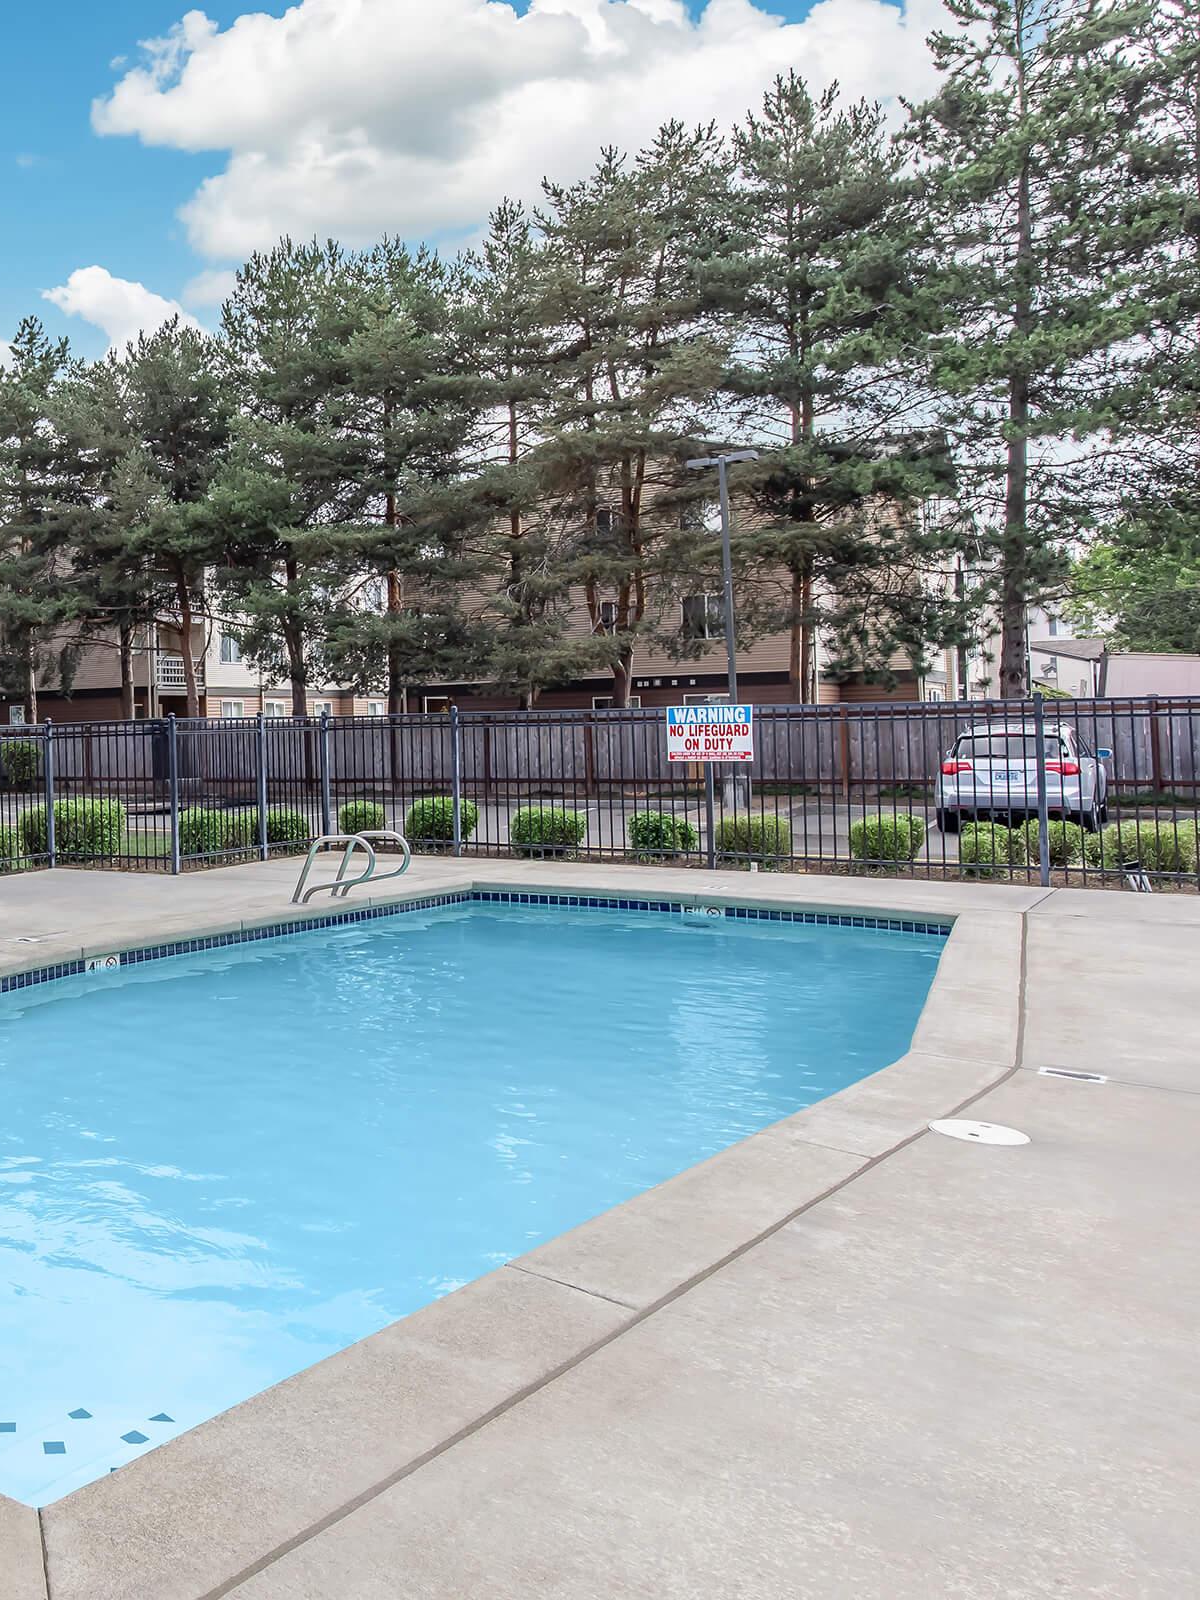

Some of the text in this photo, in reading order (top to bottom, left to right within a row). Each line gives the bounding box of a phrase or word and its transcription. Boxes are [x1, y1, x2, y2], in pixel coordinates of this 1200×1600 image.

[674, 707, 746, 723] WARNING
[669, 724, 749, 737] NO LIFEGUARD
[685, 738, 733, 750] ON DUTY
